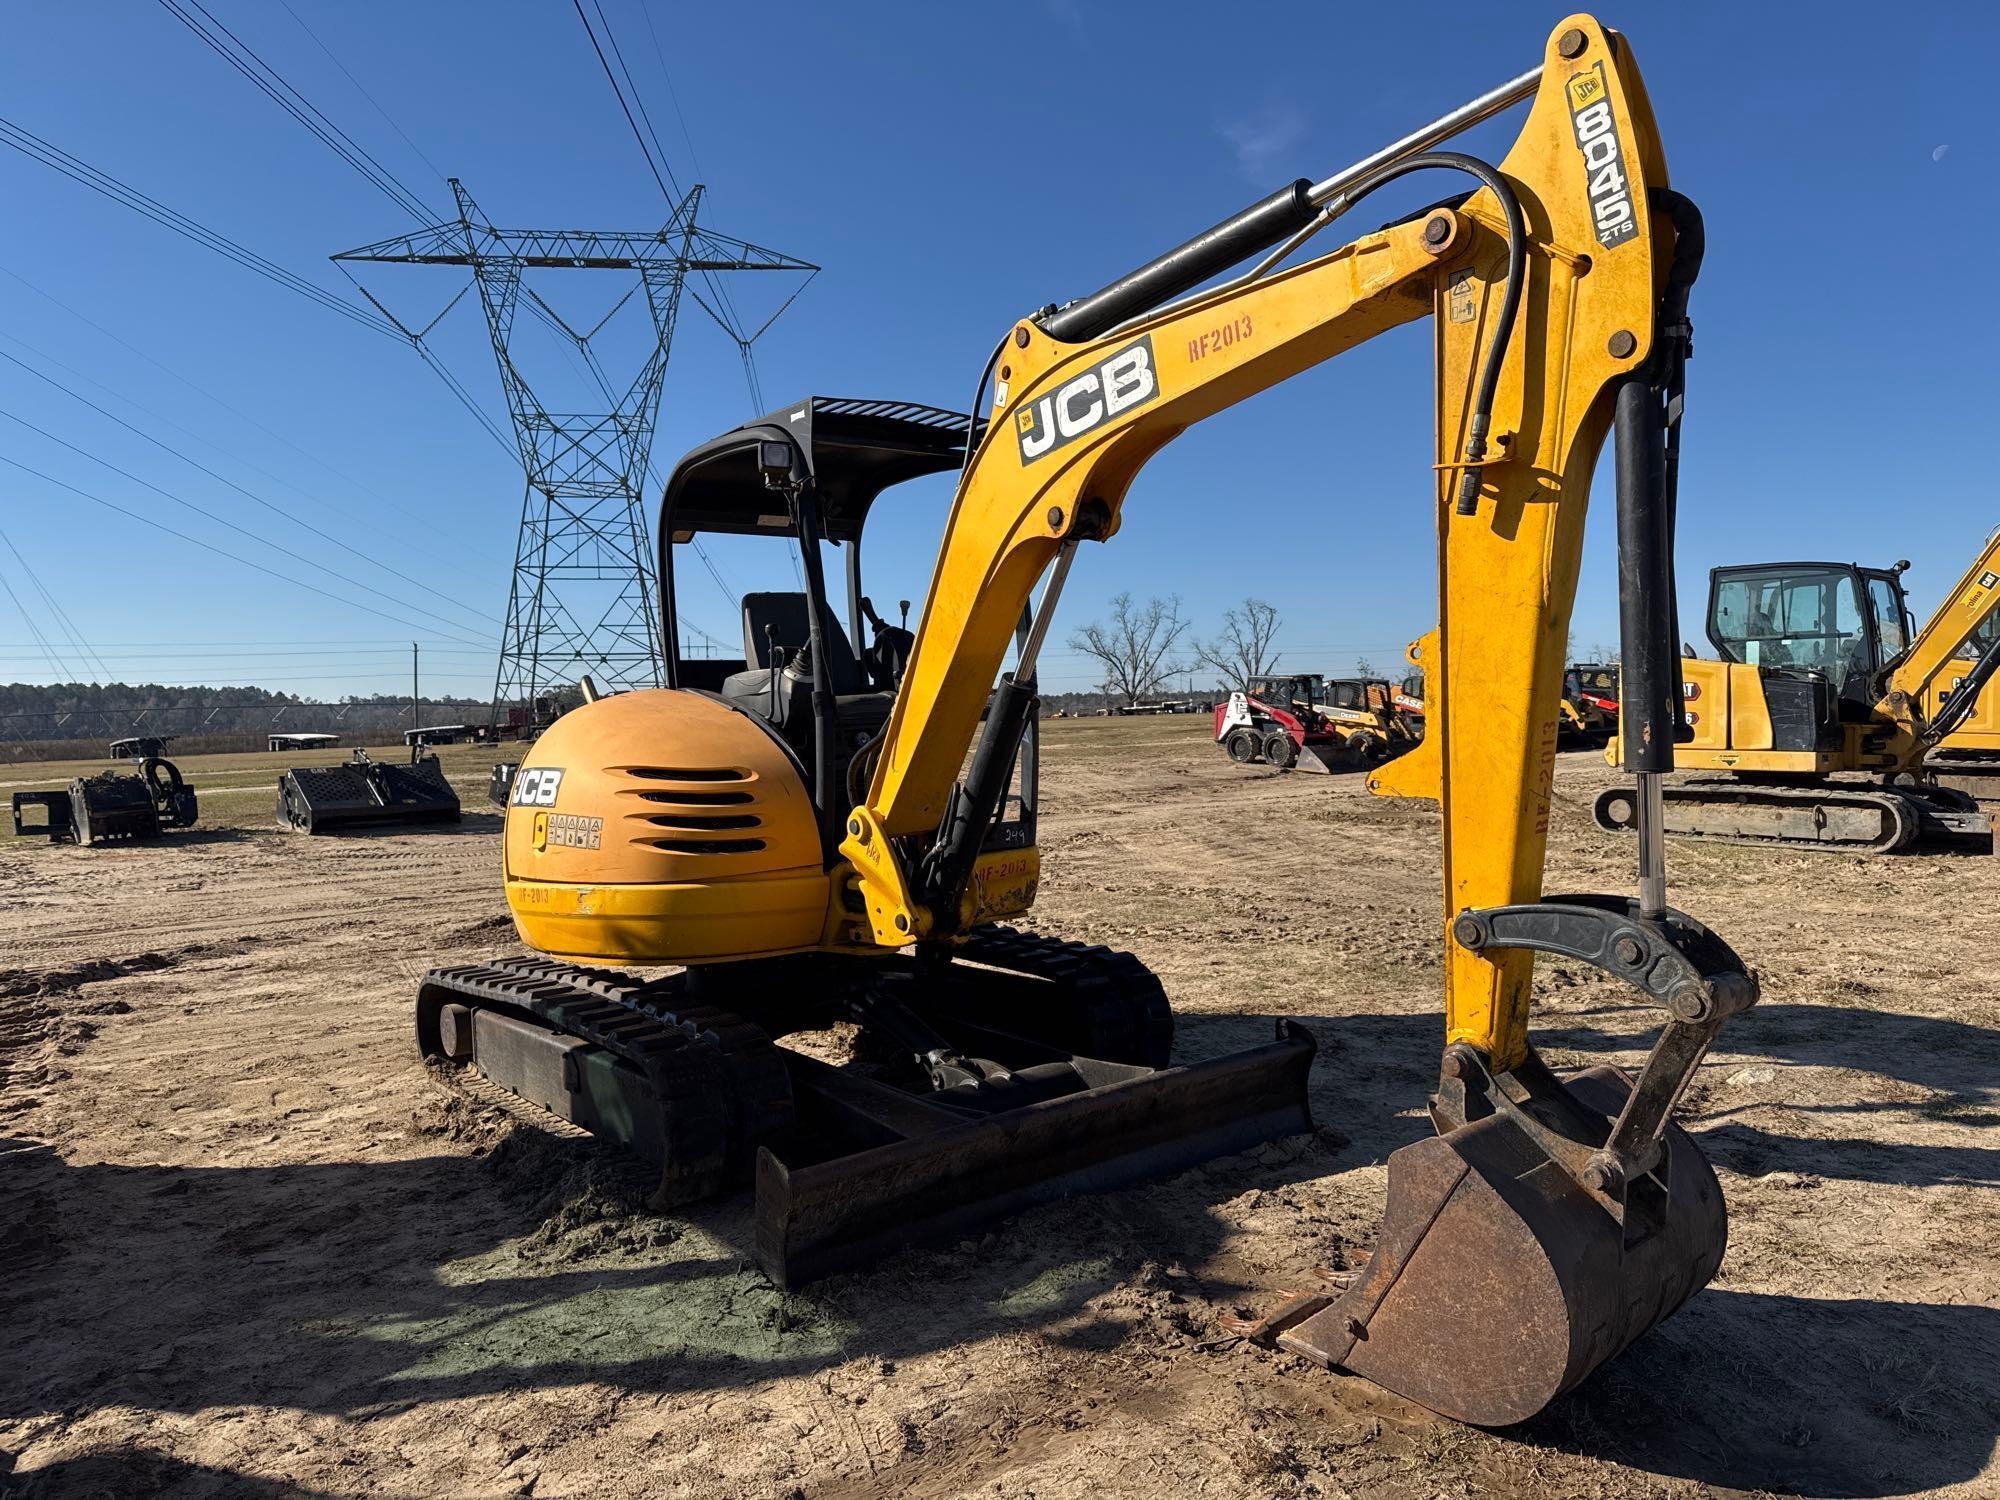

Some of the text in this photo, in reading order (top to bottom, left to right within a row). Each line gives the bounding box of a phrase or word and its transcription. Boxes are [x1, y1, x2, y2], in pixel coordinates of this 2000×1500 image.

[1578, 80, 1598, 99] JCB
[1576, 101, 1631, 230] 8045
[1600, 219, 1634, 243] ZTS
[1022, 346, 1154, 458] JCB
[1981, 573, 1996, 587] CAT
[1395, 695, 1424, 709] CASE
[512, 770, 561, 804] JCB
